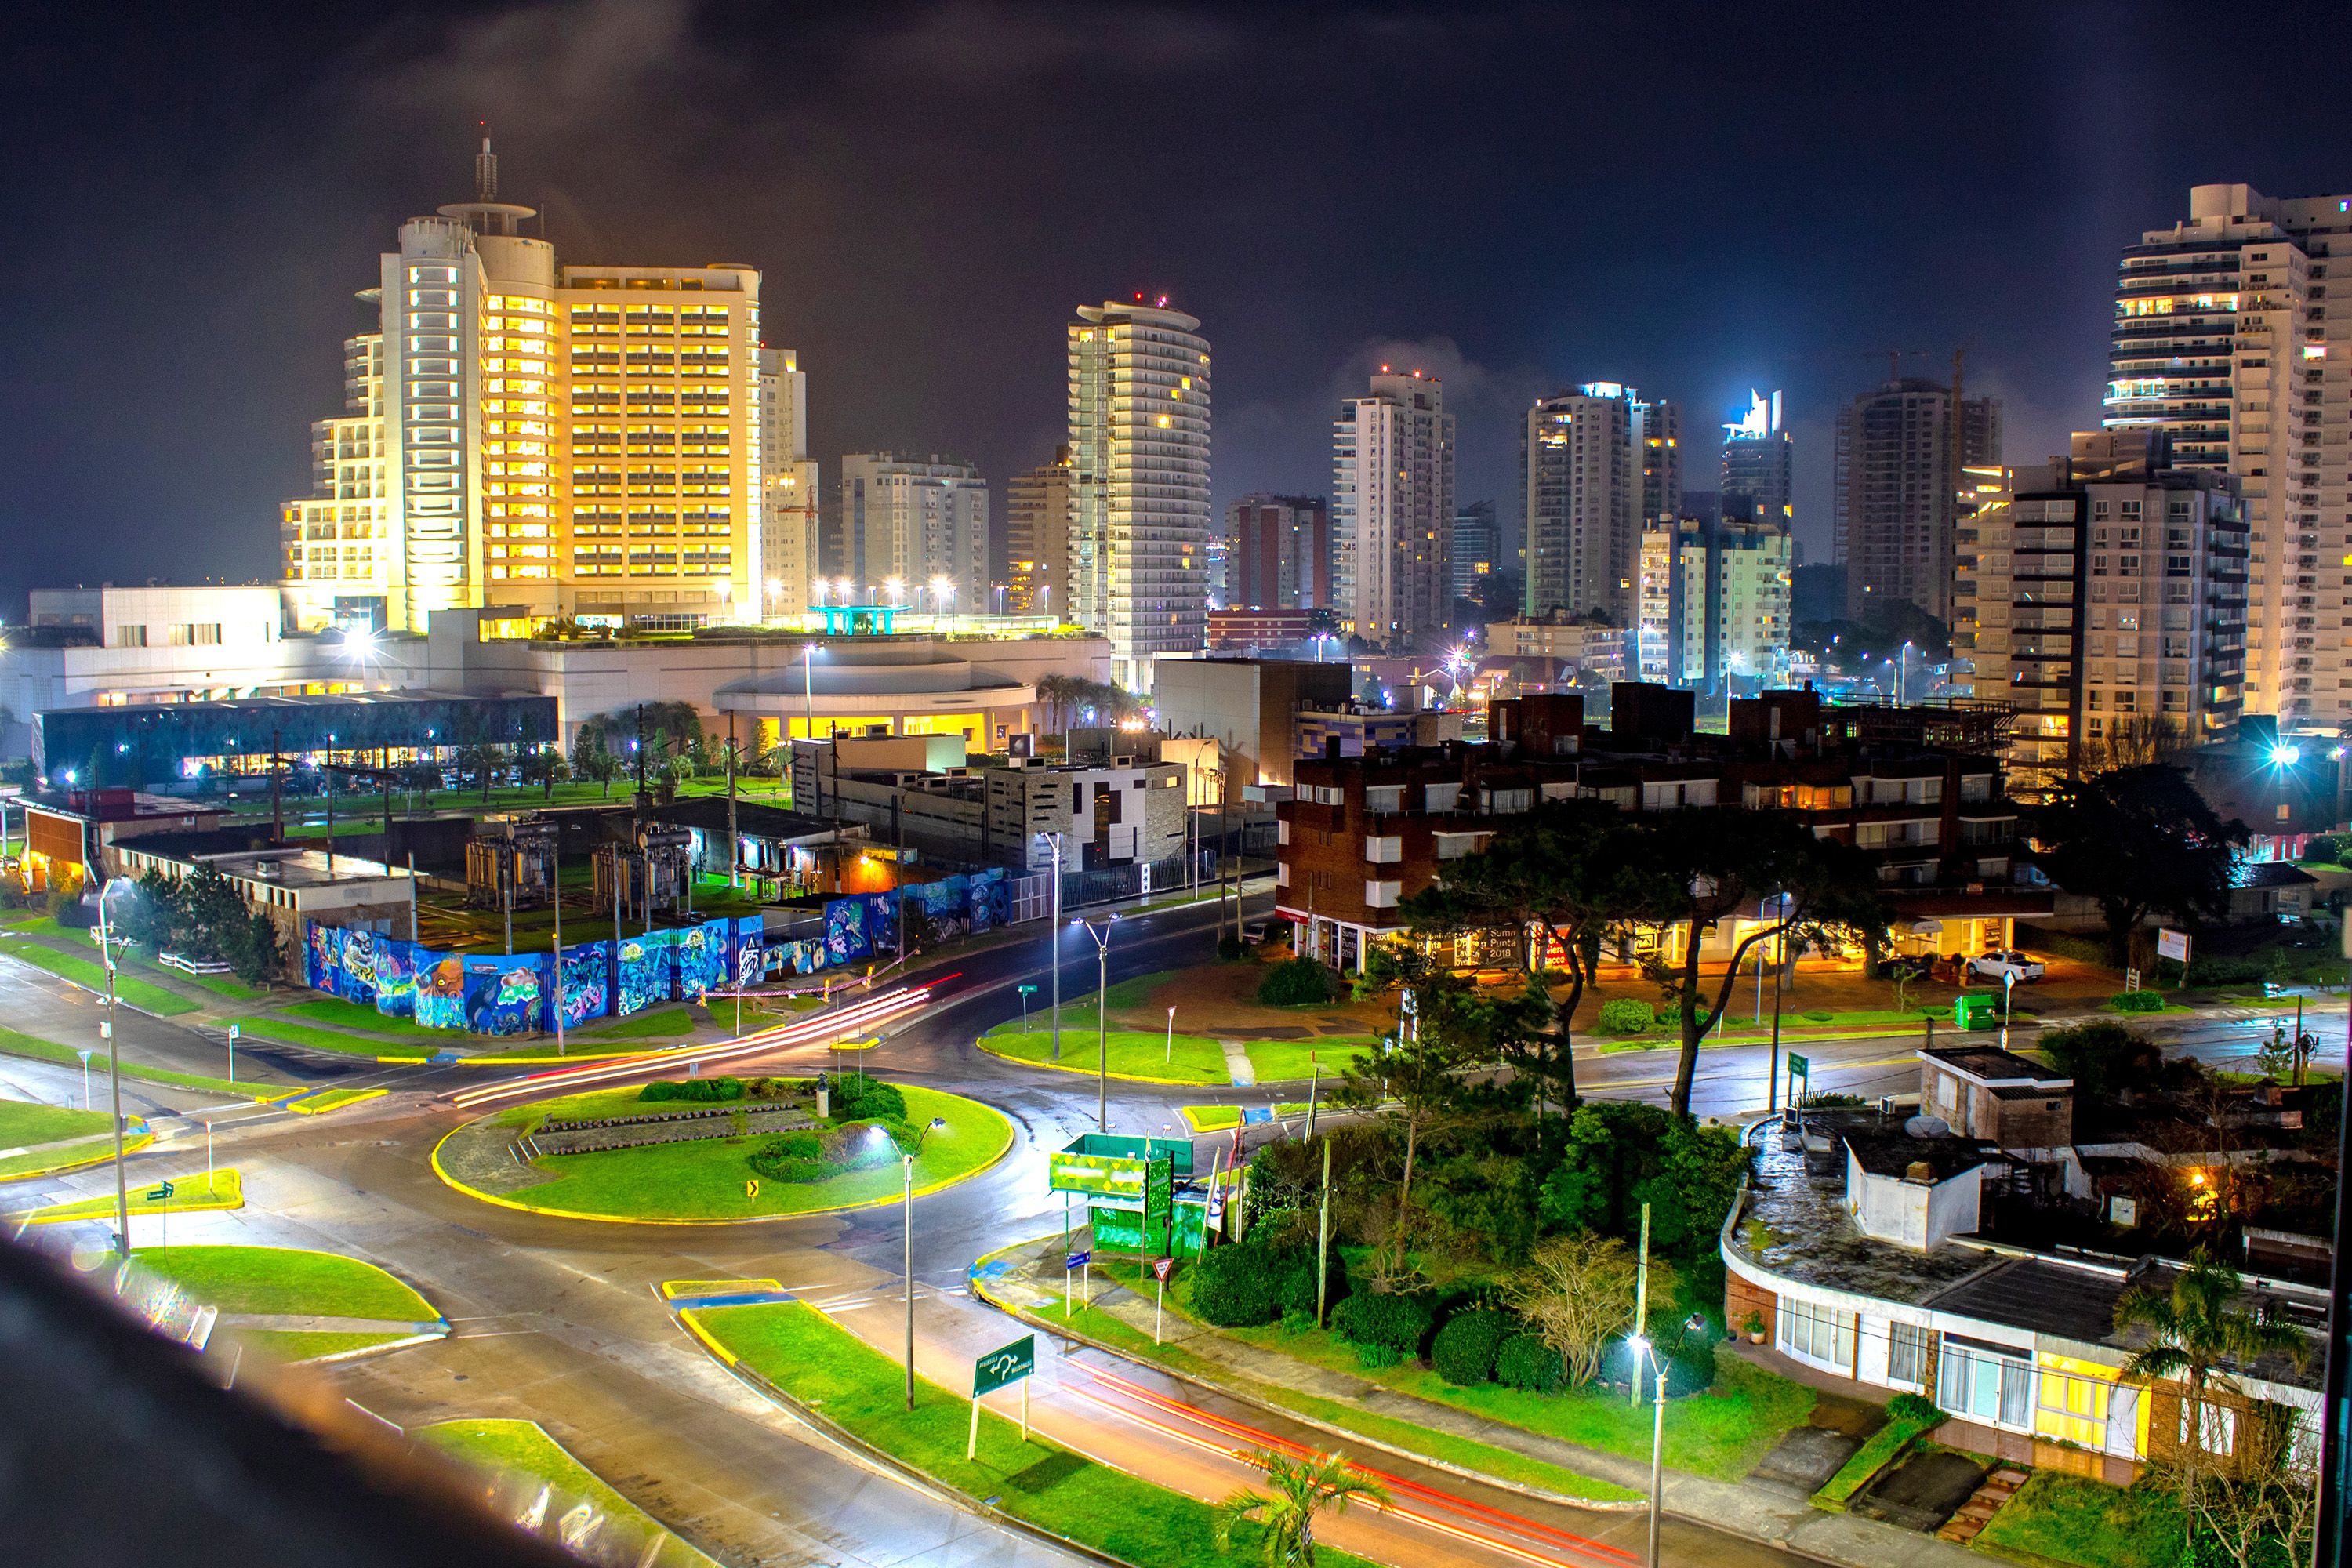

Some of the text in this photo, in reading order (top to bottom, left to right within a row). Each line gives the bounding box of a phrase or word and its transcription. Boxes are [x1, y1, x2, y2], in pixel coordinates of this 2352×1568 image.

[1490, 938, 1516, 947] Punta
[1341, 949, 1355, 959] 2018
[1490, 949, 1512, 957] 2018
